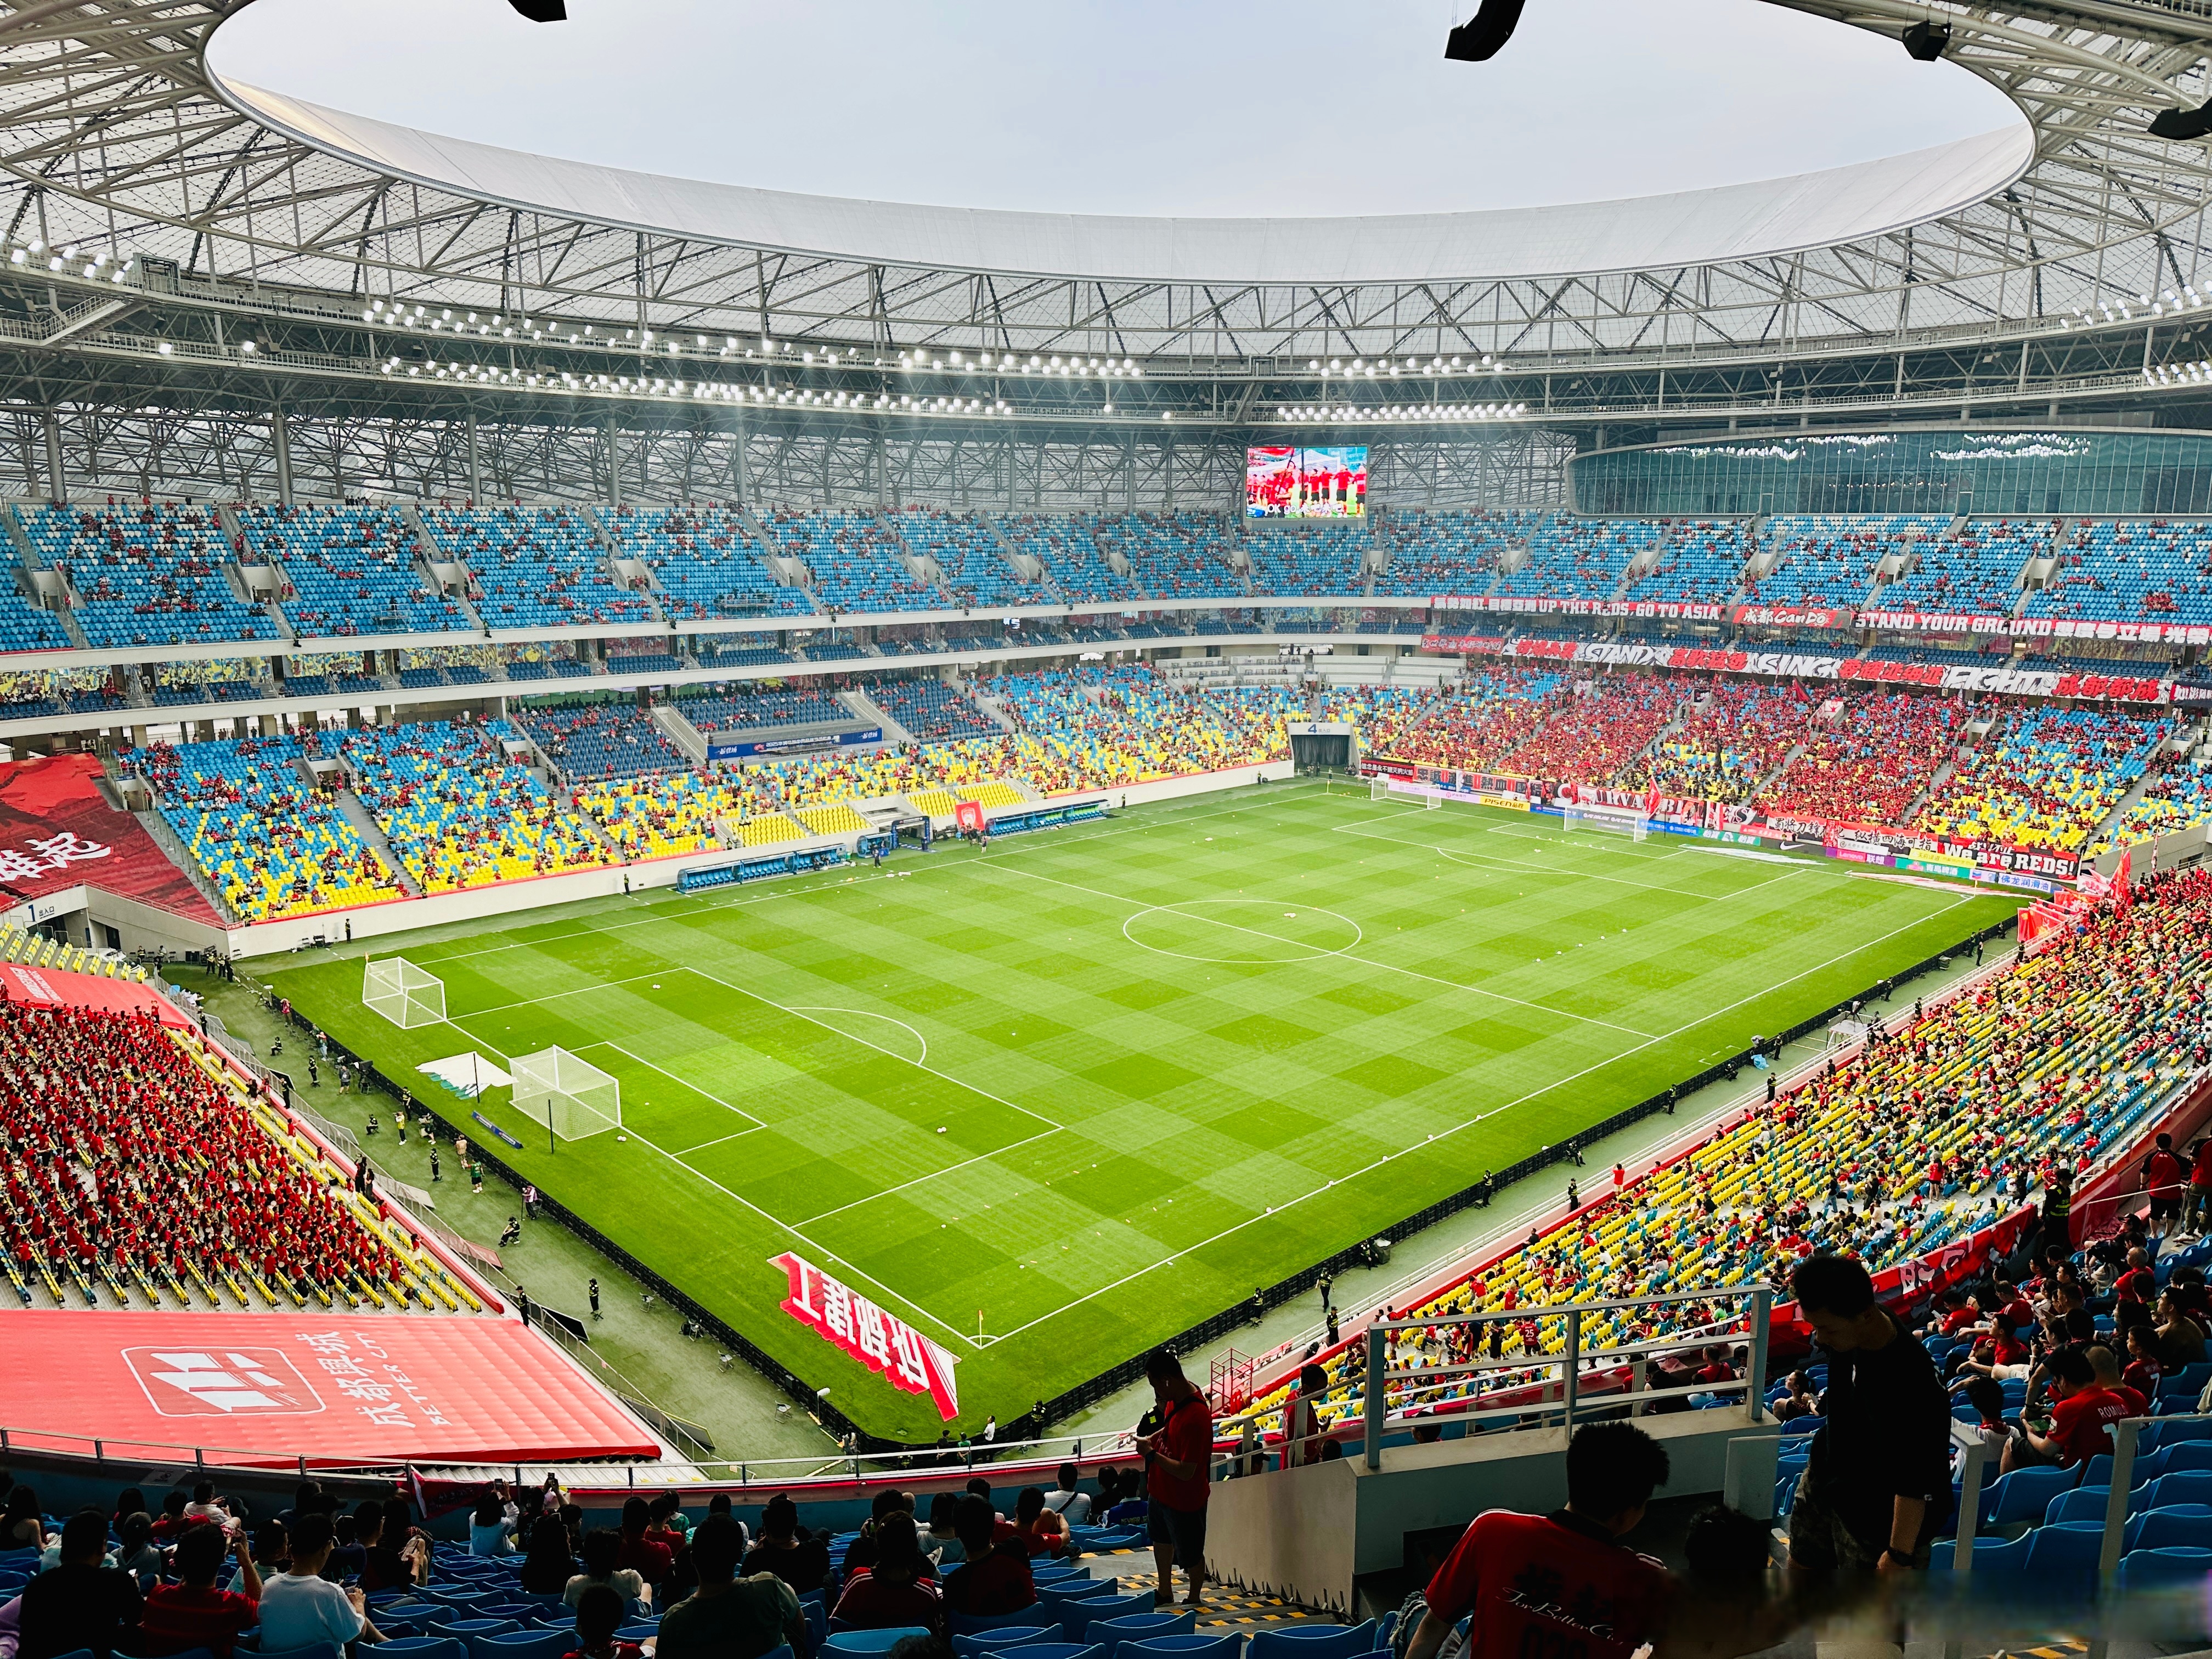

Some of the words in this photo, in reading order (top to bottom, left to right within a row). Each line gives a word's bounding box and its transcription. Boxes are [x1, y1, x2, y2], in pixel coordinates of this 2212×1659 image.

[1267, 504, 1280, 514] OK
[1539, 600, 1557, 613] UP
[1561, 601, 1589, 614] THE
[1635, 603, 1655, 617] GO
[1658, 605, 1679, 618] TO
[1681, 605, 1719, 620] ASIA
[1855, 612, 1915, 630] STAND
[1920, 615, 1968, 631] YOUR
[1971, 618, 2052, 636] GROUND
[1585, 644, 1655, 665] STAND
[1757, 653, 1840, 678] SING
[1945, 665, 2045, 695] FIGHT
[1308, 724, 1317, 733] 4
[1839, 851, 1864, 860] Lenovo
[1866, 855, 1885, 865] 联想
[1944, 842, 1973, 859] We
[1976, 851, 2012, 868] are
[2015, 853, 2075, 876] REDS!
[1926, 864, 1959, 876] 青岛啤酒
[2000, 874, 2049, 891] 佛龙润滑油
[29, 905, 36, 922] 1
[39, 906, 54, 917] 出入口
[1525, 1329, 1534, 1338] 25
[352, 1331, 388, 1359] CITY
[2150, 1373, 2160, 1398] 7
[382, 1364, 452, 1426] BETTER
[2098, 1403, 2129, 1419] ROMULO
[1494, 1586, 1532, 1610] For
[1532, 1602, 1588, 1630] Better
